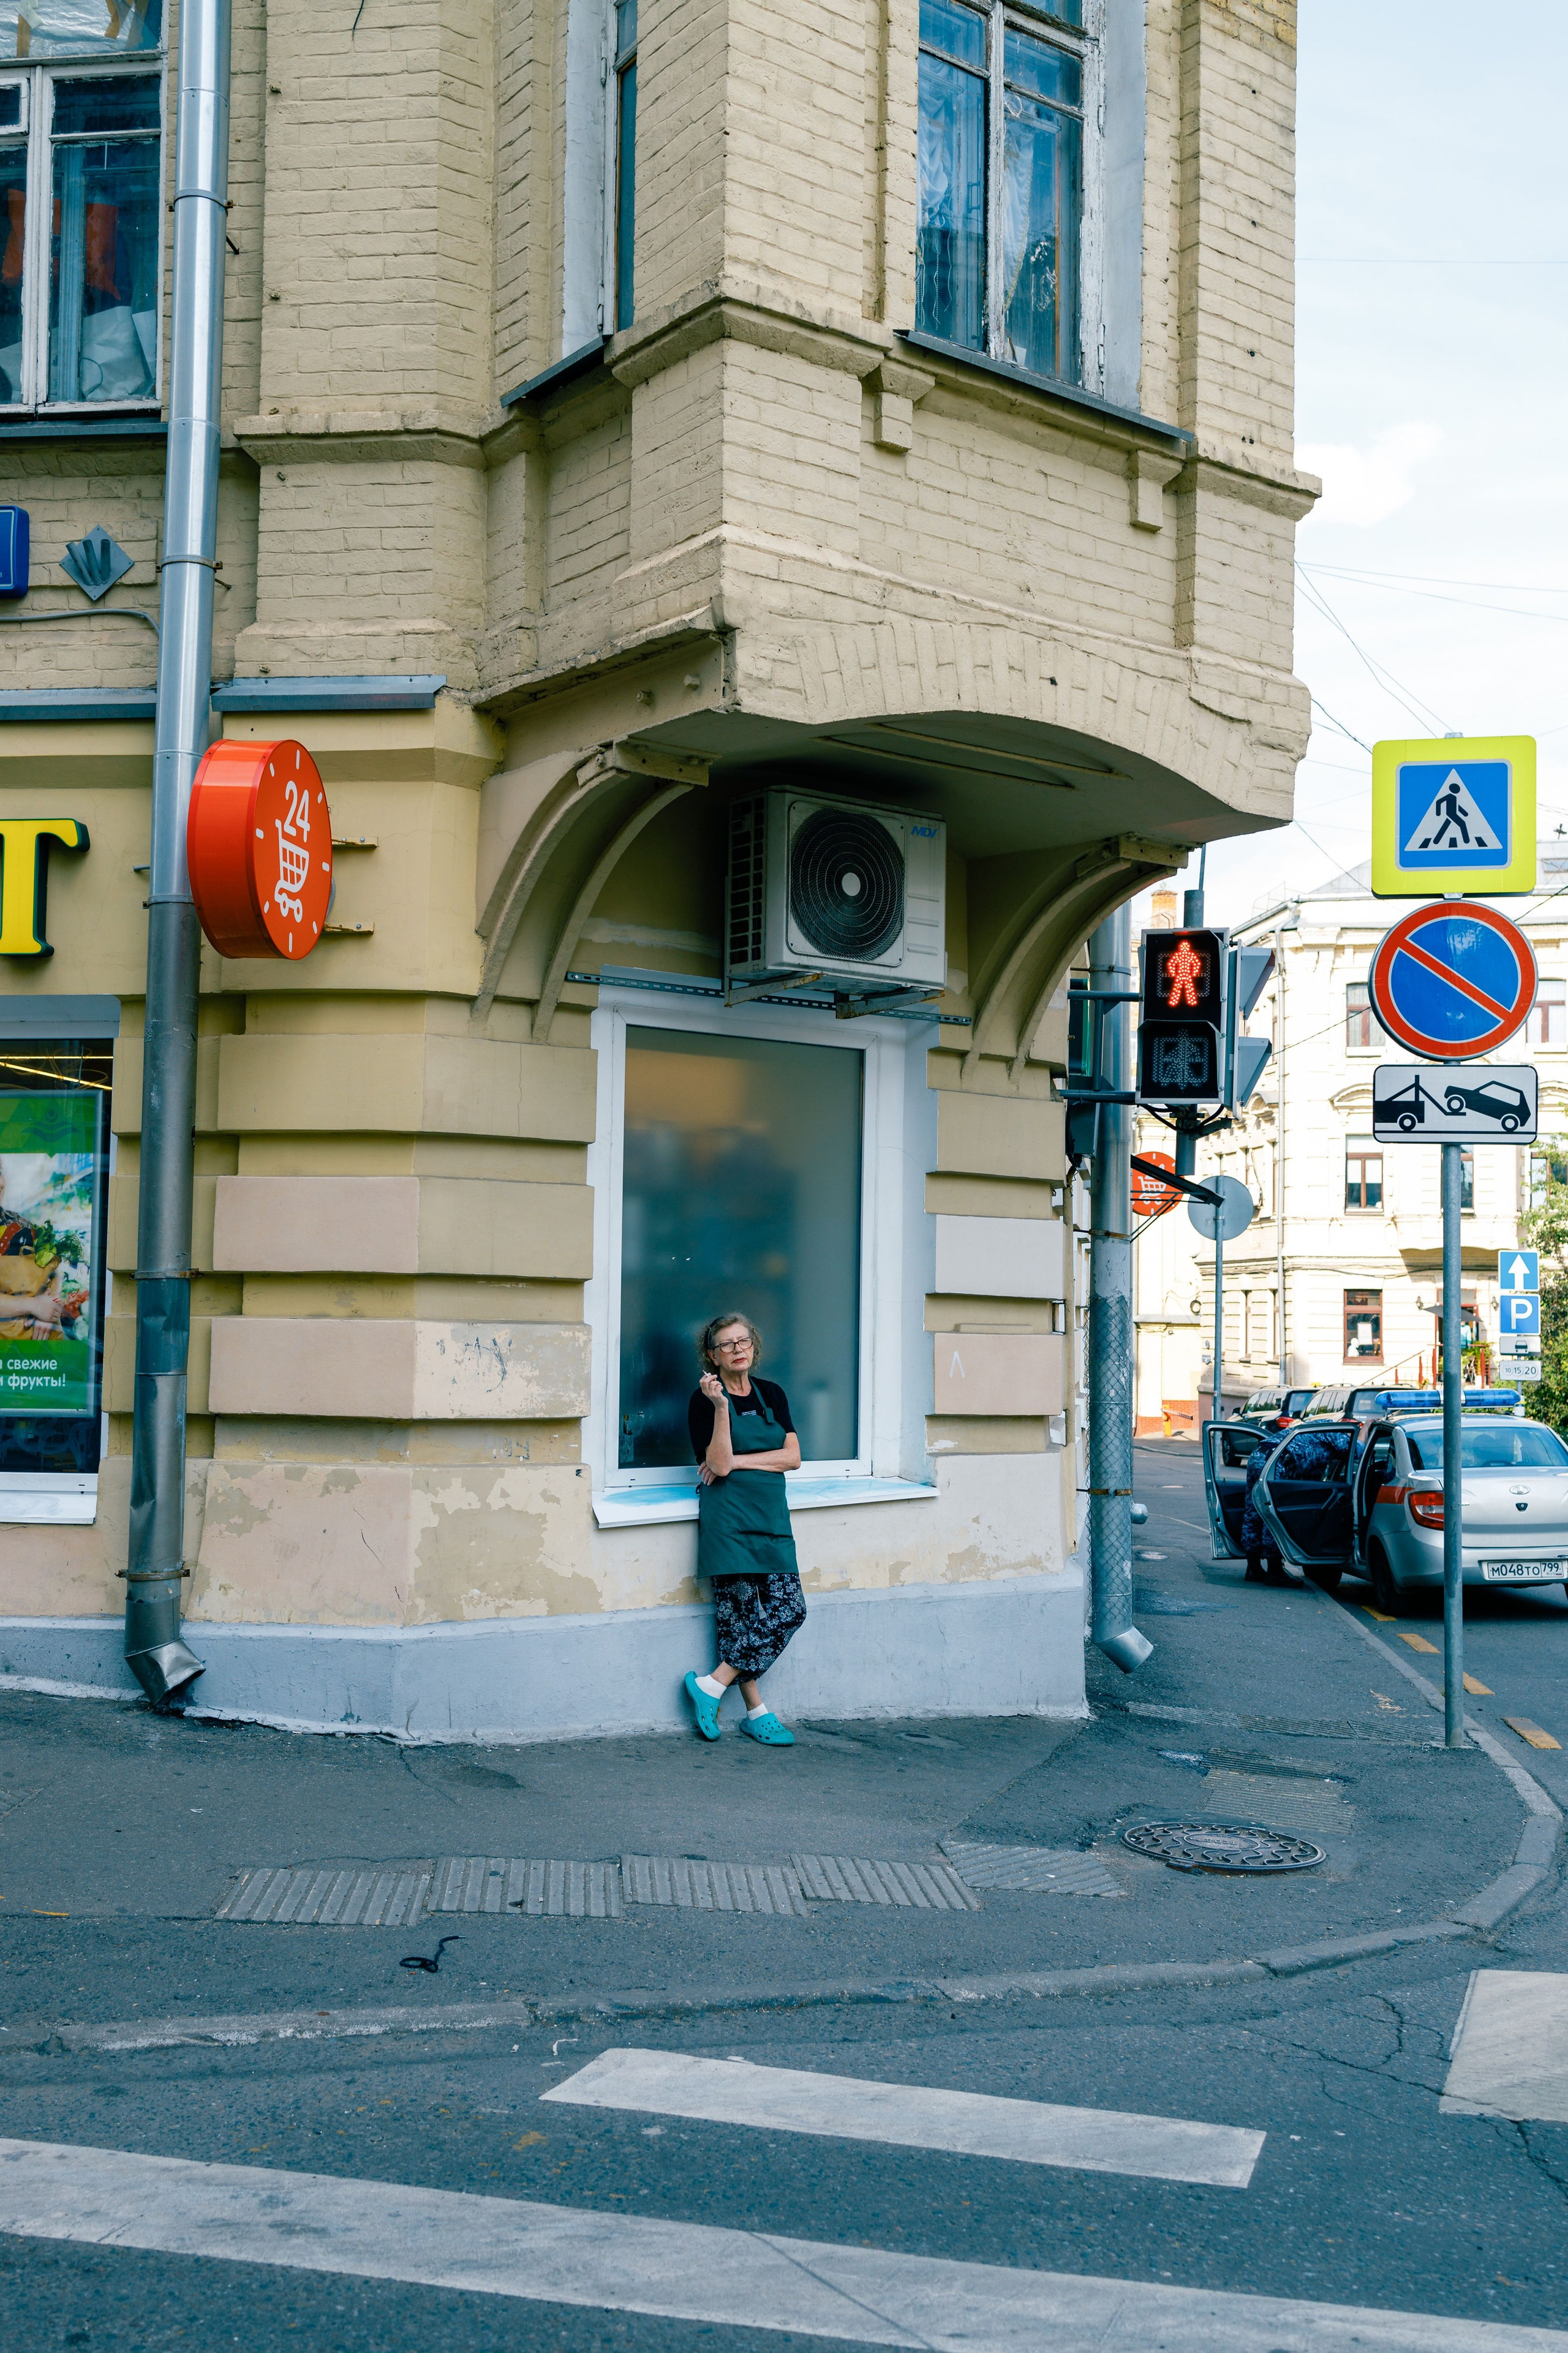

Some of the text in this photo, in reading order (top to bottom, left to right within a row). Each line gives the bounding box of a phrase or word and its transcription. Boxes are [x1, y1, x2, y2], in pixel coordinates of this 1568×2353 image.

[284, 780, 311, 843] 24
[1510, 1298, 1533, 1330] P
[7, 1359, 58, 1370] свежие
[1524, 1366, 1537, 1375] 20
[7, 1373, 66, 1391] фрукты!
[1541, 1562, 1559, 1572] 799
